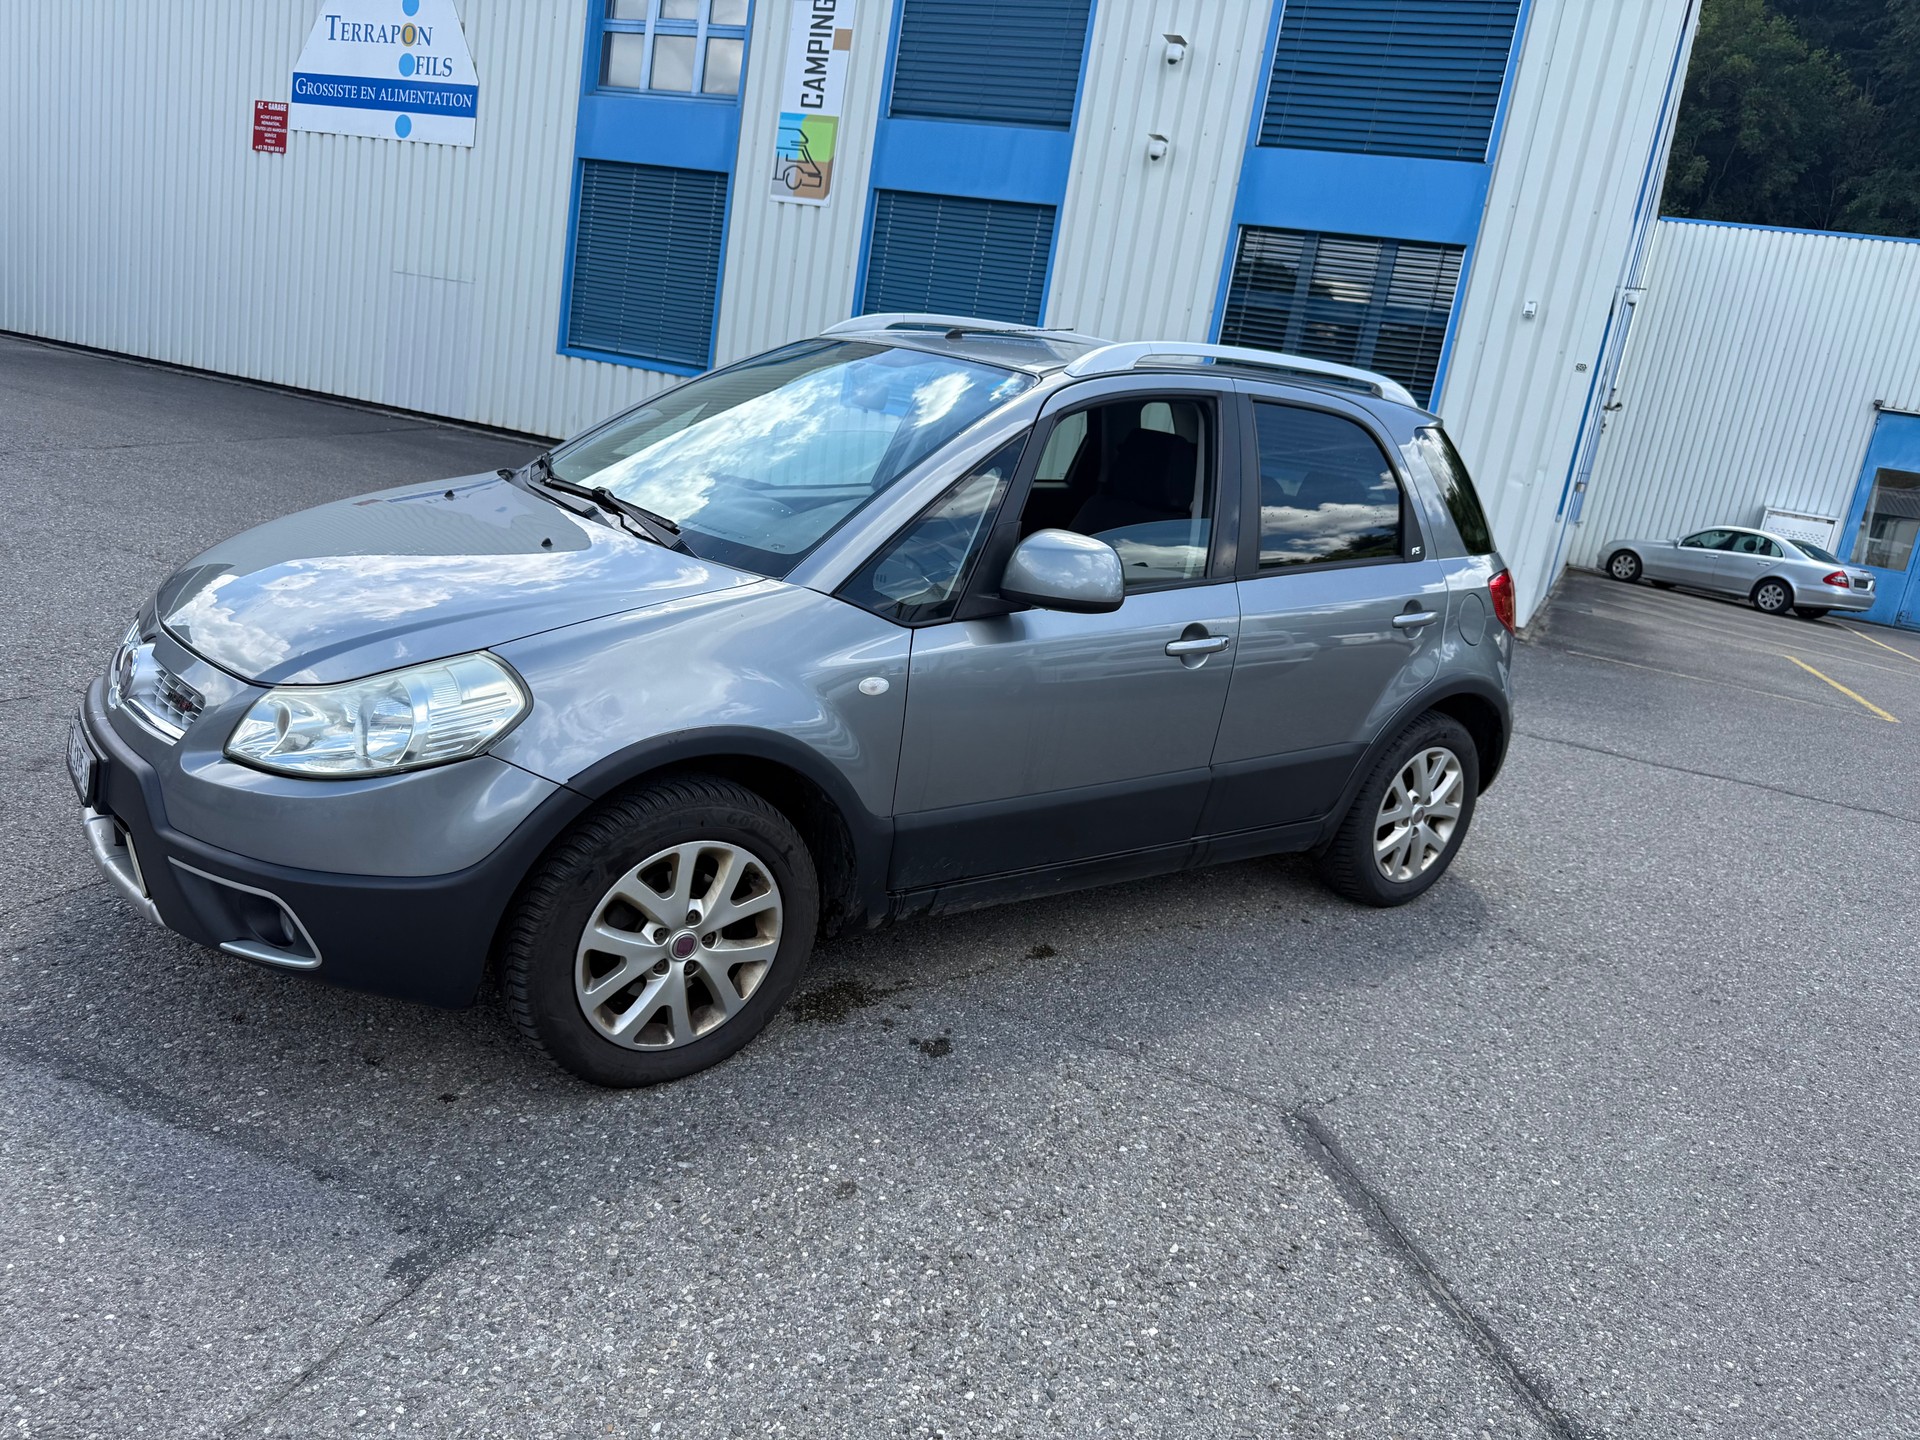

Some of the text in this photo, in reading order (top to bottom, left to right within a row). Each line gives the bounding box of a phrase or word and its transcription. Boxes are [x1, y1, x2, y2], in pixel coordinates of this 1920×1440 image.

[325, 14, 433, 47] TERRAPON
[415, 56, 453, 78] FILS
[800, 0, 836, 109] CAMPING
[268, 103, 286, 111] GARAGE
[295, 77, 473, 108] GROSSISTE EN ALIMENTATION
